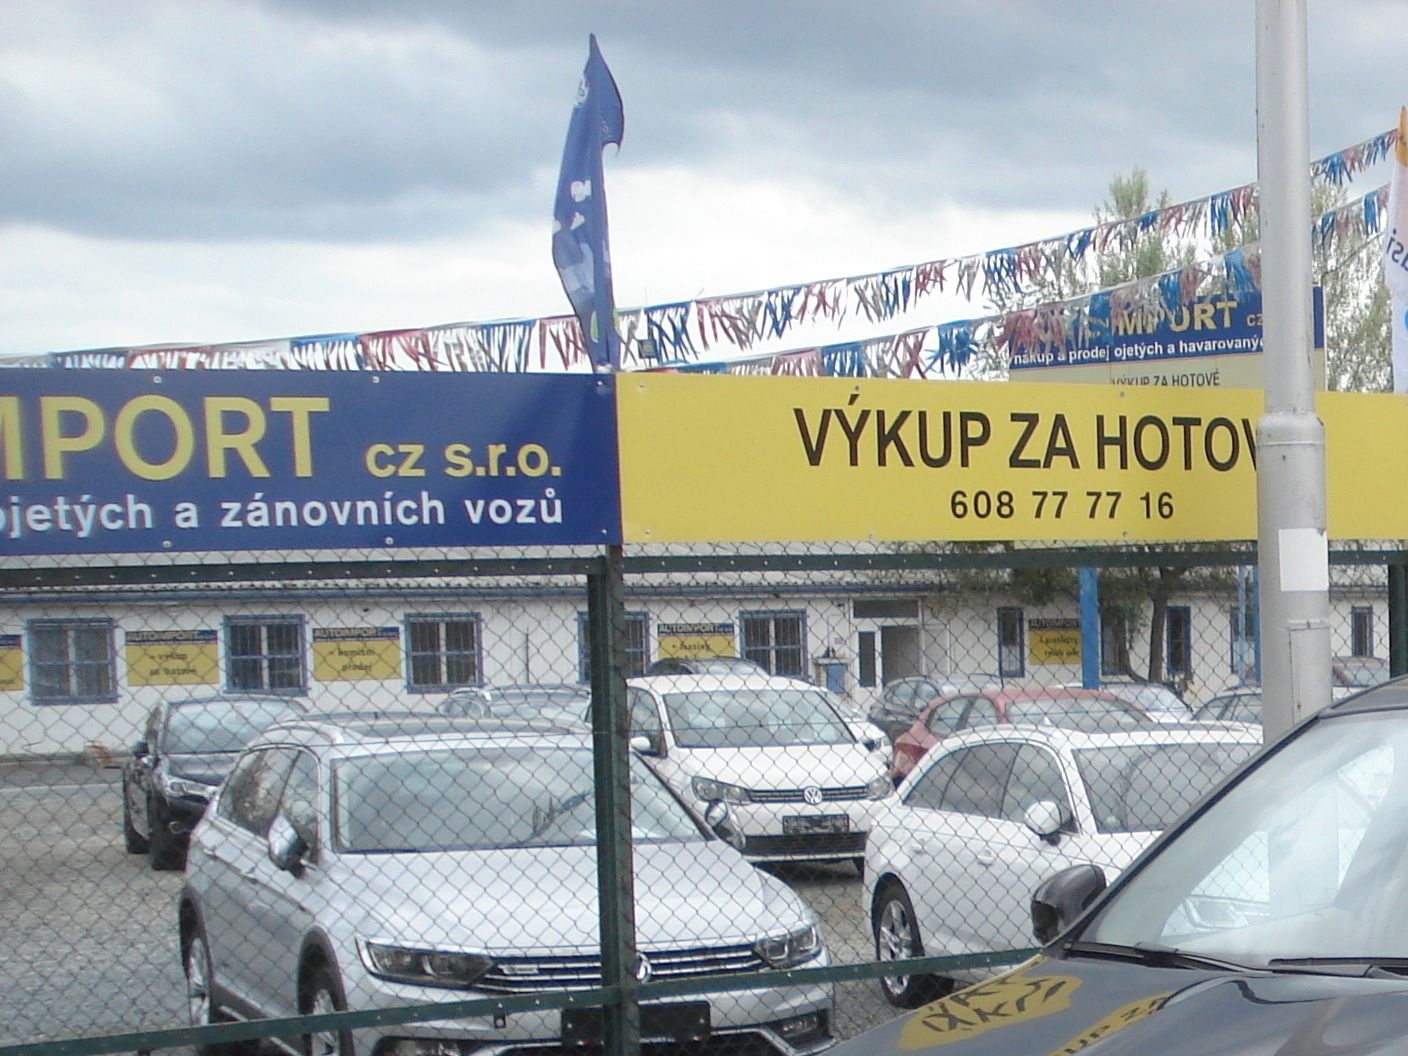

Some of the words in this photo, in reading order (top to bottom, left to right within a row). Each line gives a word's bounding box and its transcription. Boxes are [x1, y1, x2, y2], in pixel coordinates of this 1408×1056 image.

[1068, 345, 1110, 364] prodej
[1114, 340, 1163, 361] ojetých
[1167, 343, 1176, 354] a
[1179, 334, 1263, 354] havarovaný
[1171, 368, 1221, 388] HOTOVÉ
[793, 393, 992, 468] VÝKUP
[1009, 412, 1081, 470] ZA
[365, 443, 426, 478] cz
[443, 443, 562, 478] s.r.o.
[174, 500, 198, 529] a
[220, 490, 445, 528] zánovních
[464, 487, 562, 525] vozů
[950, 489, 1015, 519] 608
[1031, 491, 1068, 519] 77
[1086, 491, 1122, 519] 77
[1140, 491, 1174, 519] 16
